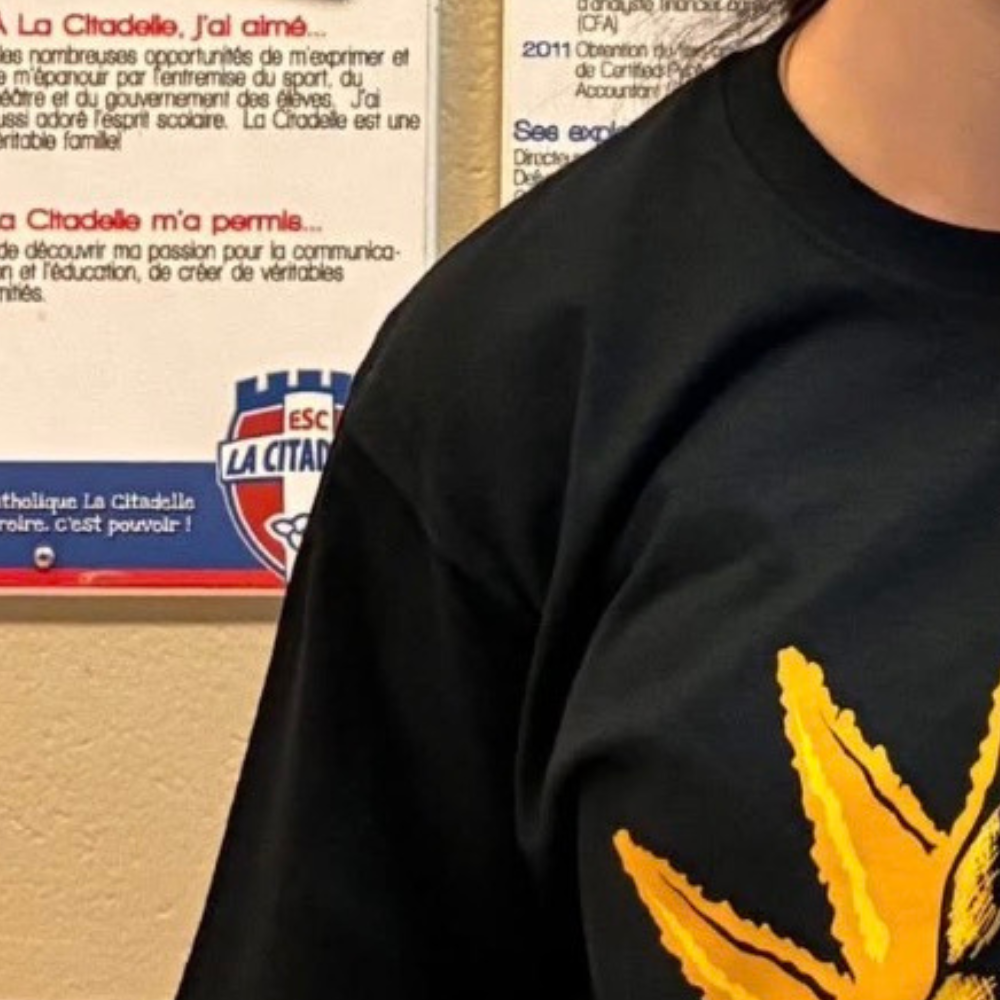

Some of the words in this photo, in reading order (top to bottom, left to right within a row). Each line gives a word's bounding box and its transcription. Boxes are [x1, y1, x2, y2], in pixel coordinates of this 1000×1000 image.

[17, 14, 53, 36] La
[522, 41, 571, 58] 2011
[243, 109, 266, 129] La
[353, 109, 381, 129] est
[387, 113, 421, 129] une
[513, 119, 559, 142] Ses
[26, 208, 142, 231] Citadelle
[151, 209, 202, 231] m'a
[24, 239, 106, 259] découvrir
[113, 243, 142, 259] ma
[147, 239, 216, 263] passion
[223, 243, 264, 263] pour
[270, 239, 286, 259] la
[289, 407, 329, 431] ESC
[226, 444, 257, 475] LA
[263, 438, 331, 472] CITAD
[83, 492, 105, 509] La
[111, 492, 195, 509] Citadelle
[108, 515, 181, 536] pouvoir
